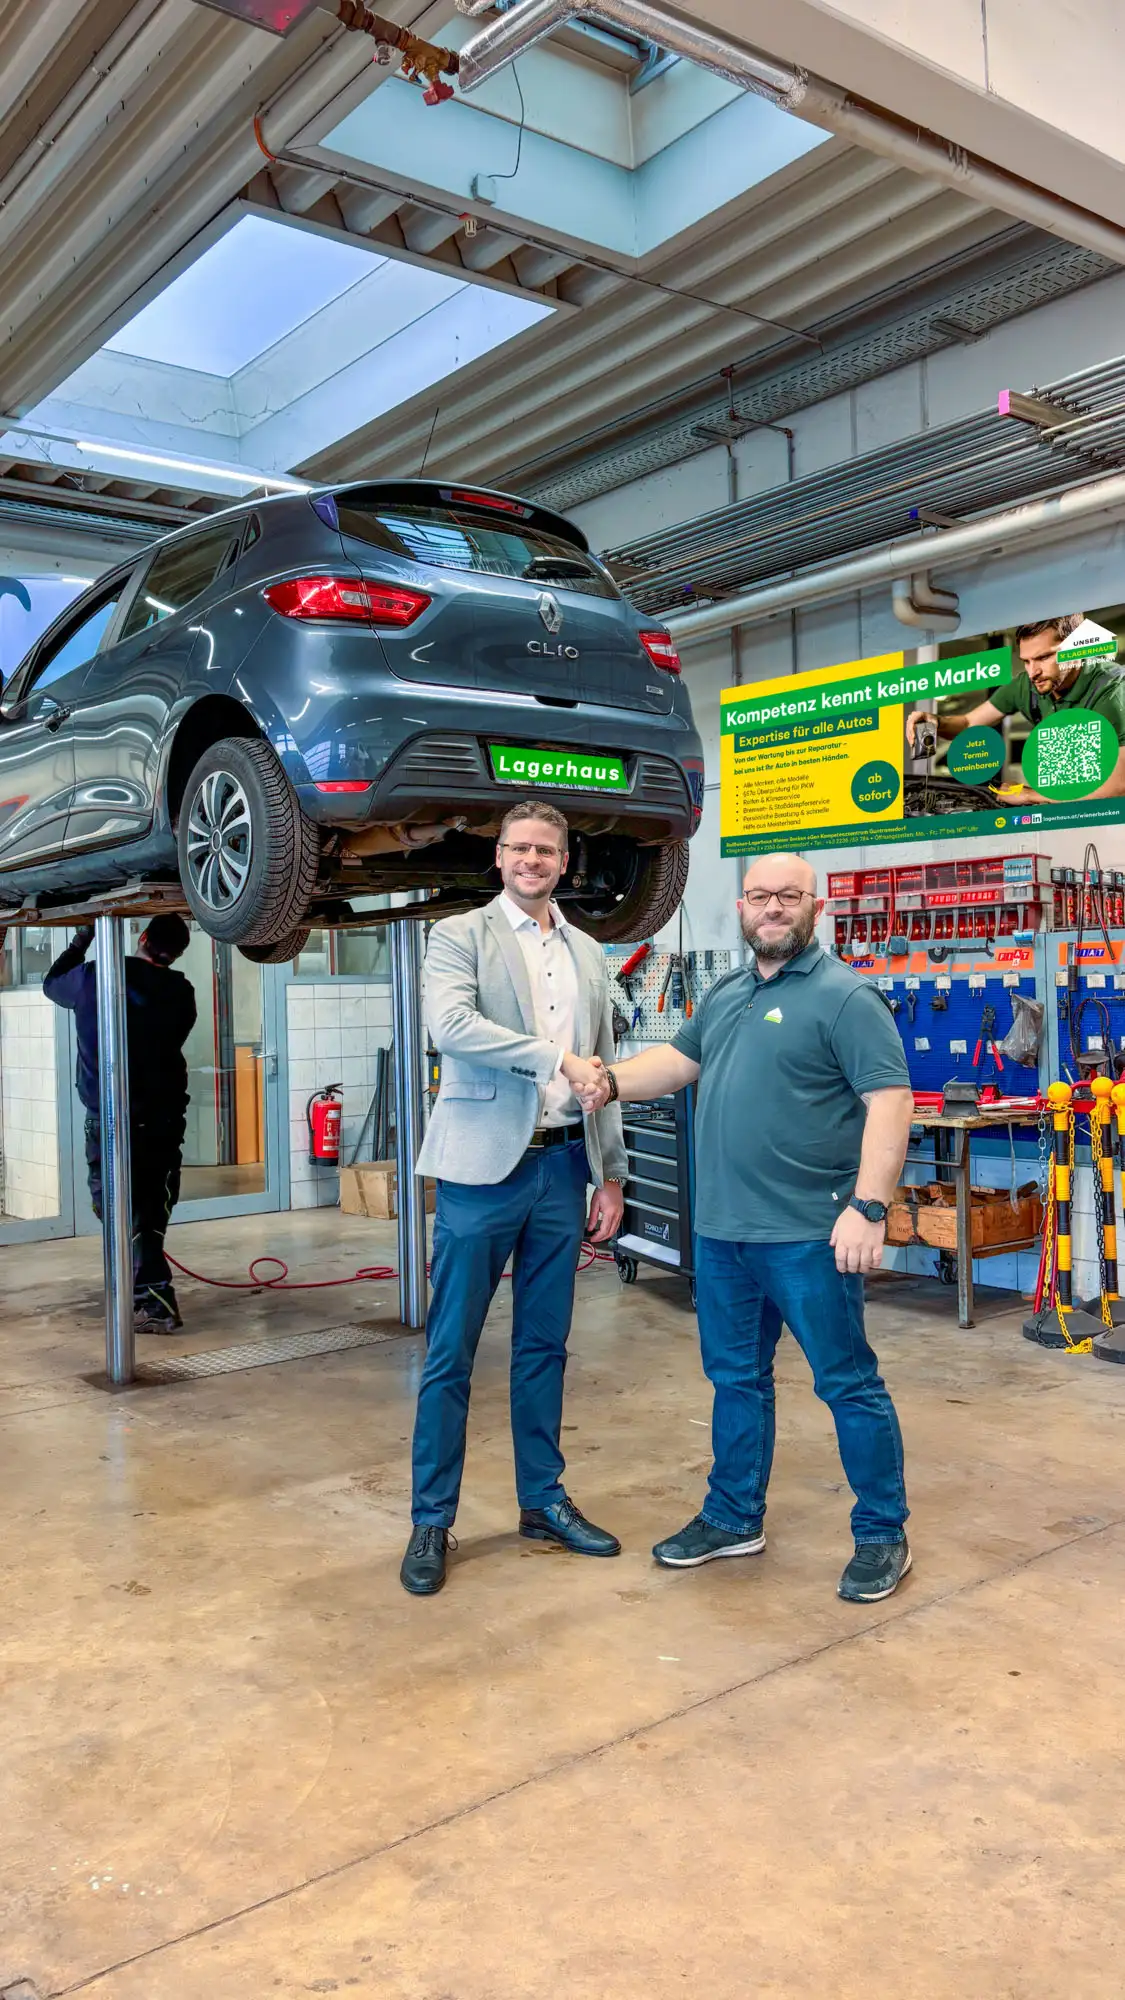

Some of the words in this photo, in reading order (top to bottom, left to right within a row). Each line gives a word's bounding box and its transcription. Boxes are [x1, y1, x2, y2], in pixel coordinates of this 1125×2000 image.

[1073, 636, 1100, 647] UNSER
[526, 640, 580, 659] CLIO
[1067, 644, 1115, 658] LAGERHAUS
[1058, 661, 1085, 671] Wiener
[1087, 656, 1116, 666] Becken
[726, 699, 817, 727] Kompetenz
[821, 686, 872, 709] kennt
[877, 677, 929, 699] keine
[934, 661, 1001, 688] Marke
[739, 729, 791, 747] Expertise
[792, 726, 810, 738] für
[812, 721, 834, 735] alle
[836, 716, 873, 731] Autos
[965, 739, 986, 748] Jetzt
[758, 751, 785, 761] Wartung
[785, 747, 795, 755] bis
[808, 742, 842, 753] Reparatur
[963, 750, 989, 760] Termin
[499, 755, 620, 781] Lagerhaus
[775, 761, 791, 769] Auto
[791, 759, 798, 767] in
[798, 757, 821, 765] besten
[822, 753, 850, 763] Händen.
[953, 760, 1000, 773] vereinbaren!
[800, 781, 815, 789] PKW
[867, 773, 883, 784] ab
[858, 788, 892, 802] sofort
[1043, 809, 1120, 822] lagerhaus.at/wienerbecken
[999, 950, 1029, 961] FIAT
